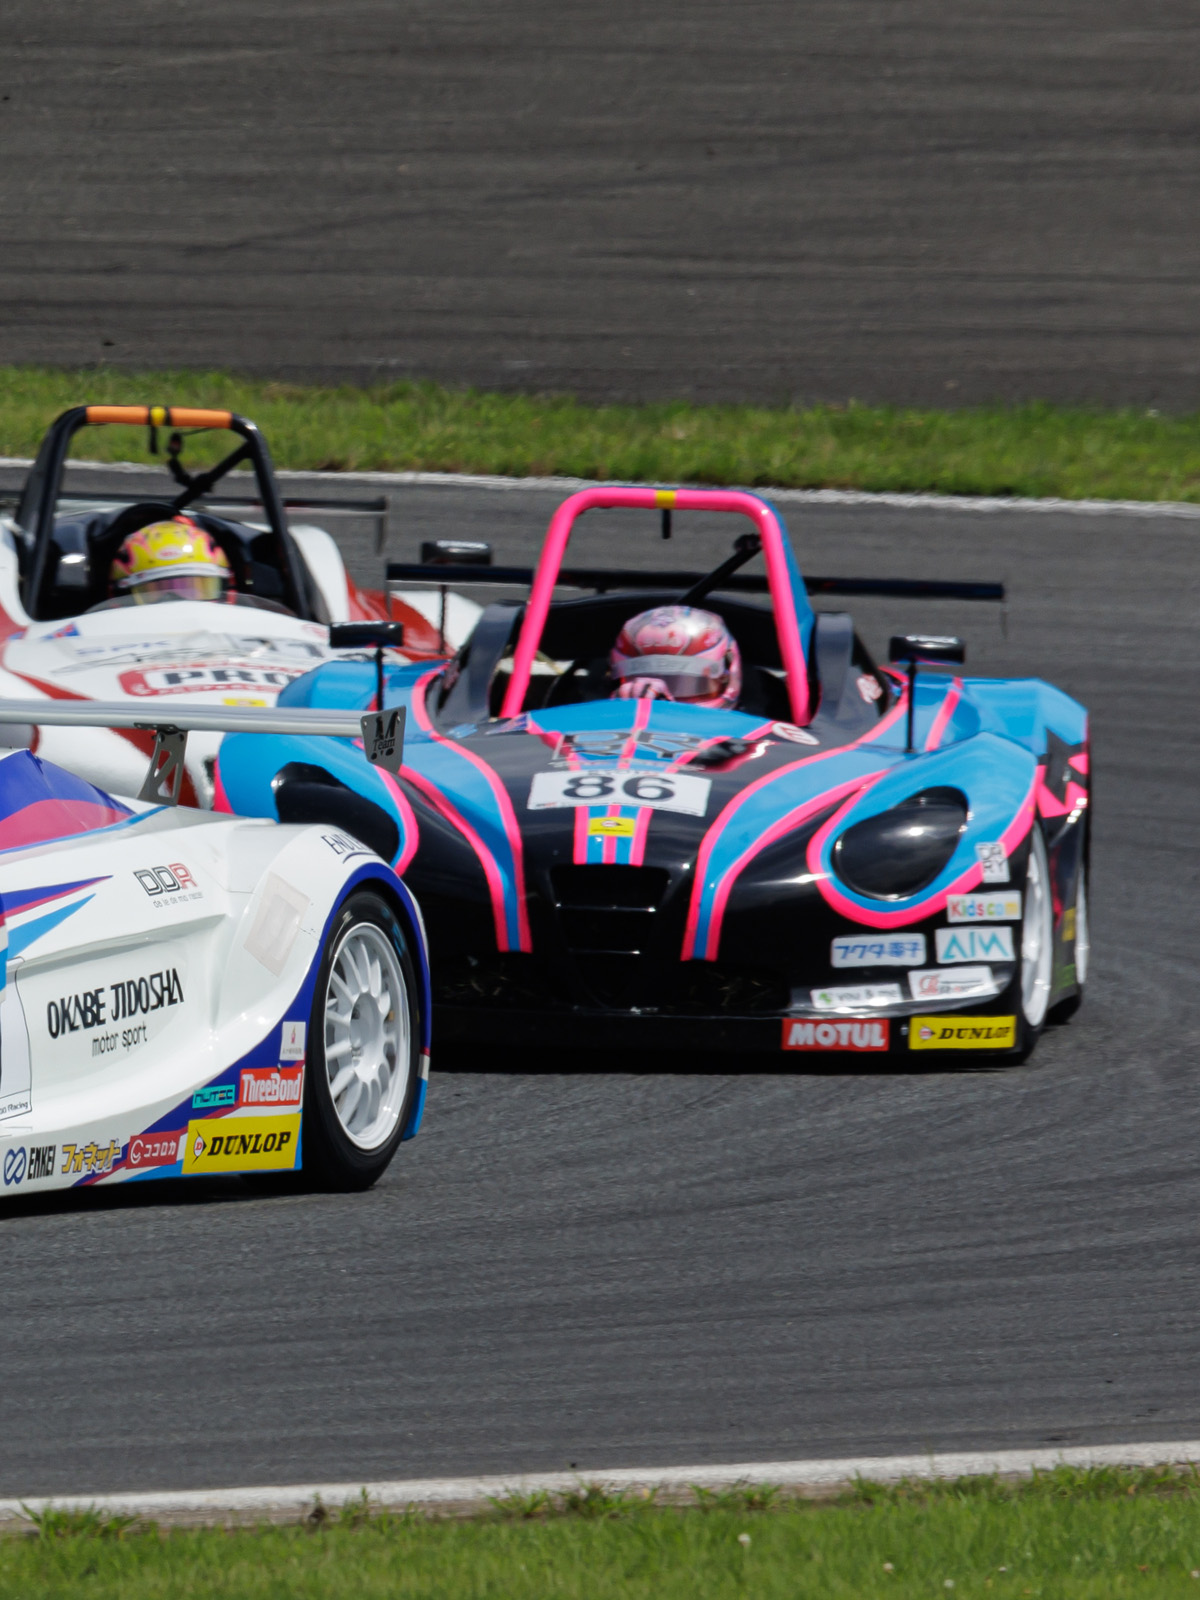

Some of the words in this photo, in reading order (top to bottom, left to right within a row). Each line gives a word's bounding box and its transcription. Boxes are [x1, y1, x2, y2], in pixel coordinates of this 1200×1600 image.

[372, 737, 396, 752] Team
[562, 774, 676, 802] 86
[46, 986, 106, 1039] OKABE
[110, 967, 185, 1022] JIDOSHA
[91, 1030, 120, 1058] motor
[120, 1023, 148, 1051] sport
[787, 1022, 885, 1048] MOTUL
[937, 1026, 1012, 1040] DUNLOP
[194, 1088, 235, 1105] NUTEC
[241, 1071, 302, 1104] ThreeBond
[143, 1139, 178, 1159] ココロカ
[206, 1131, 292, 1157] DUNLOP
[27, 1145, 55, 1181] ENKEI
